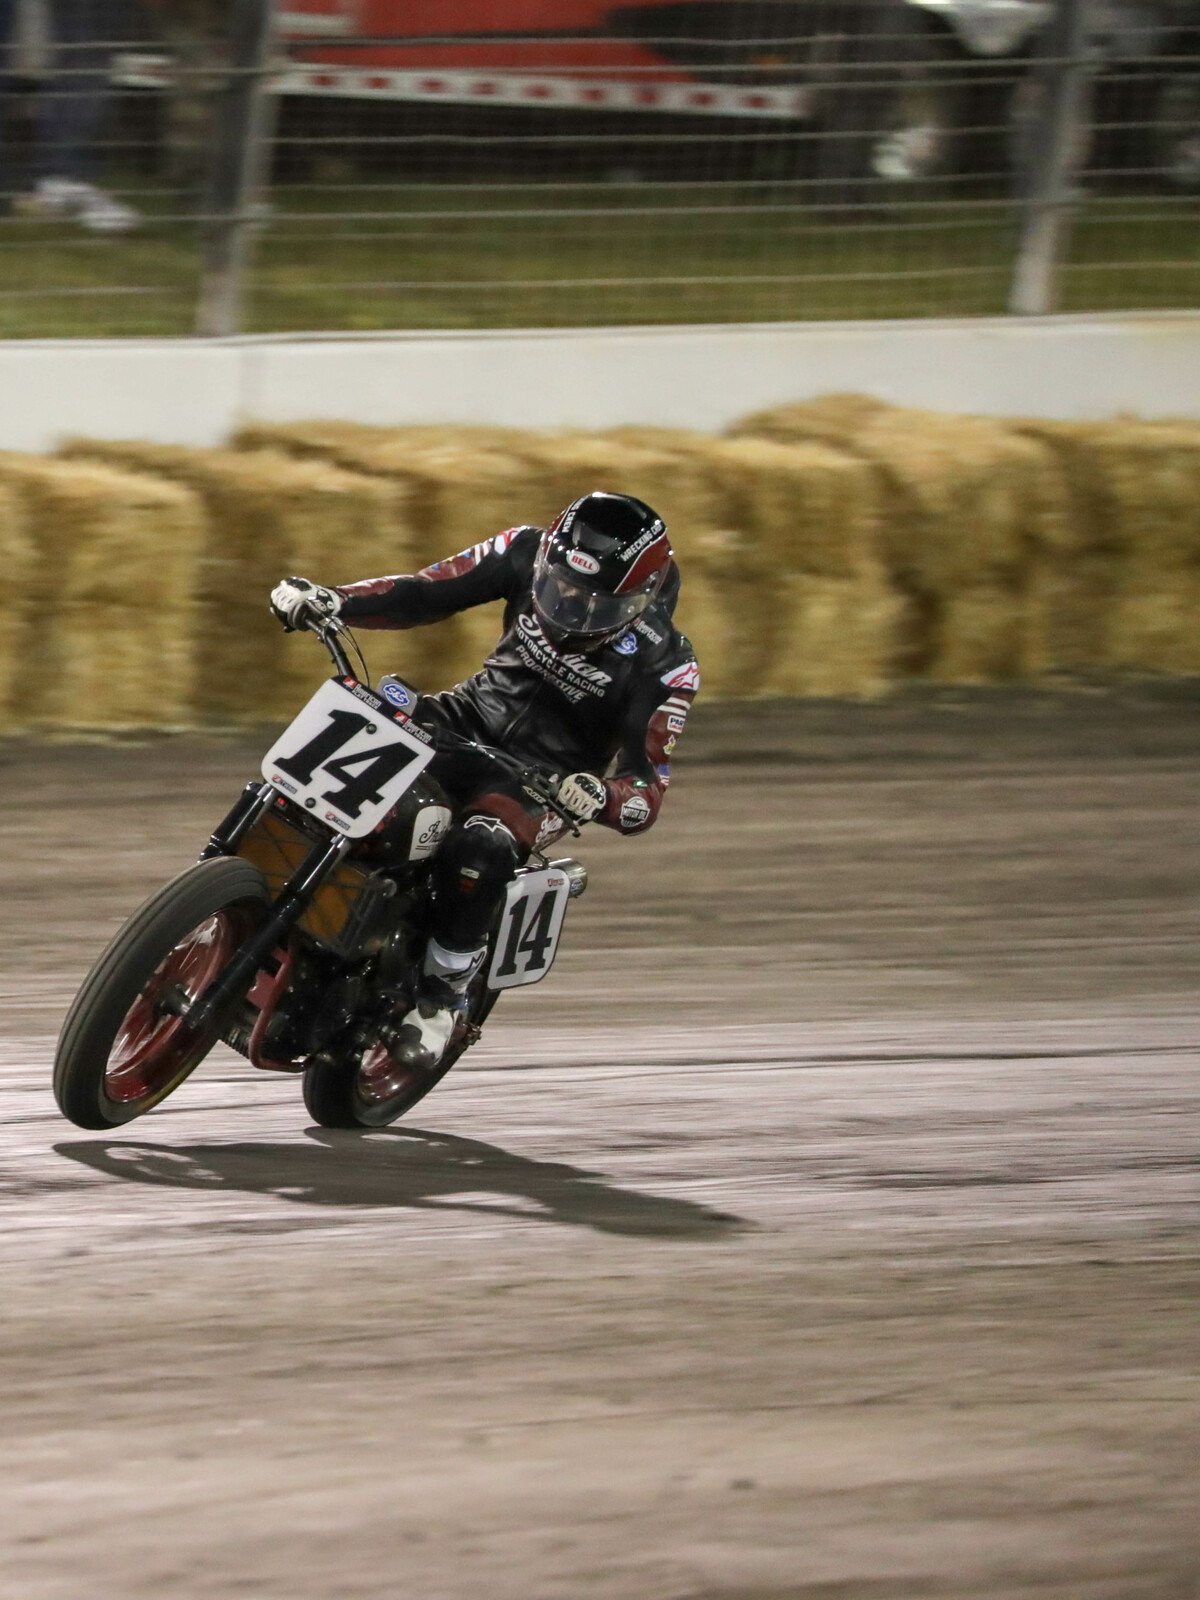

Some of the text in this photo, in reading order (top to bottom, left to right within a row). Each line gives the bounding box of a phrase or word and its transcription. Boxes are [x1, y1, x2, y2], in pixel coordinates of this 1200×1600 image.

[620, 530, 654, 562] WRECKING
[571, 555, 594, 571] BELL
[515, 624, 567, 677] MOTORCYCLE
[566, 672, 606, 697] RACING
[515, 644, 587, 700] PROGSSIVE
[352, 684, 382, 706] American
[388, 686, 409, 704] S&S
[403, 718, 432, 741] American
[273, 709, 419, 819] 14
[496, 890, 557, 977] 14
